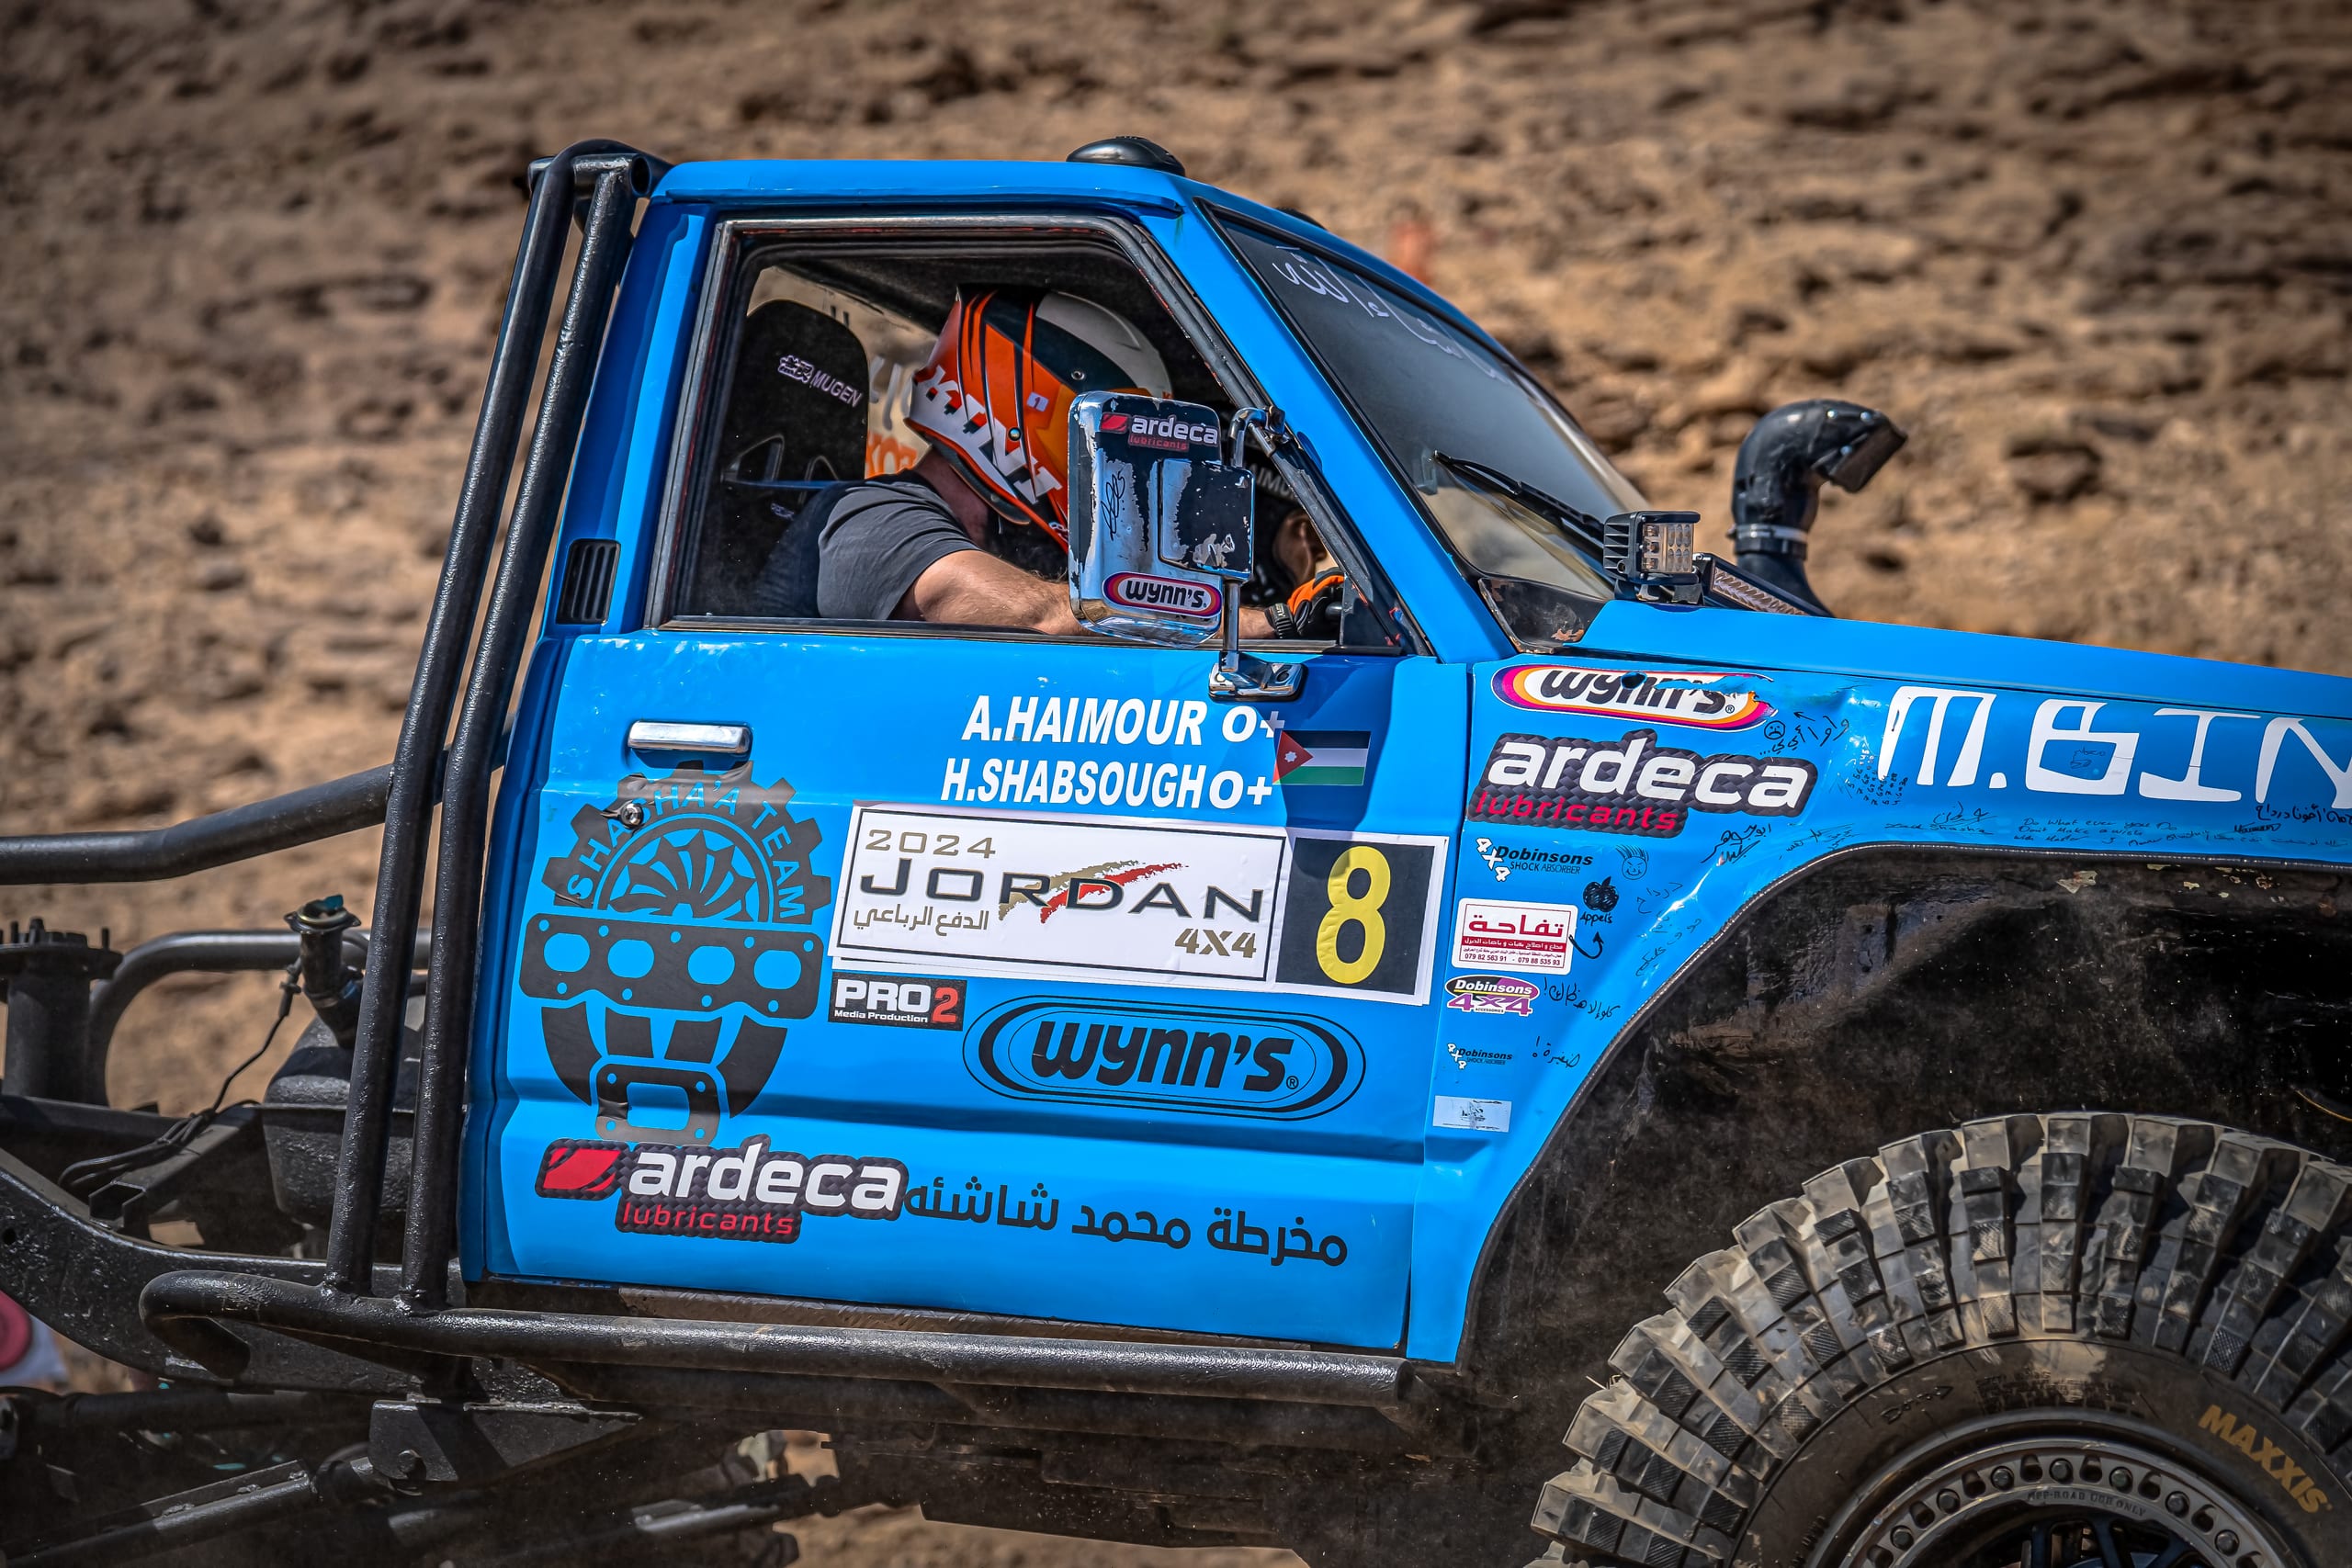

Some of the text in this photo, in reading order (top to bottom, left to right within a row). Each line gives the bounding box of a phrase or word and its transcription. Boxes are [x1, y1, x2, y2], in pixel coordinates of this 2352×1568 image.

[810, 370, 863, 408] MUGEN
[1129, 436, 1187, 450] lubricants
[1131, 415, 1218, 445] ardeca
[961, 695, 1207, 746] A.HAIMOUR
[941, 758, 1206, 808] H.SHABSOUGH
[1487, 738, 1808, 808] ardeca
[1476, 792, 1679, 830] lubricants
[752, 800, 804, 919] TEAM
[865, 829, 996, 859] 2024
[1495, 846, 1594, 865] Dobinsons
[1510, 862, 1581, 874] SHOCK ABSORBER
[860, 858, 1264, 923] JORDAN
[854, 904, 989, 937] الدفع الرباعي
[1316, 845, 1391, 984] 8
[1468, 914, 1564, 938] تفاحة
[1174, 928, 1257, 958] 4X4
[1454, 979, 1532, 995] Dobinsons
[834, 1010, 928, 1023] Media Production
[1458, 1048, 1513, 1060] Dobinsons
[628, 1143, 901, 1211] ardeca
[622, 1201, 794, 1235] lubricants
[1071, 1204, 1192, 1249] محمد
[1206, 1207, 1348, 1267] مخرطة
[2198, 1404, 2328, 1513] MAXXIS
